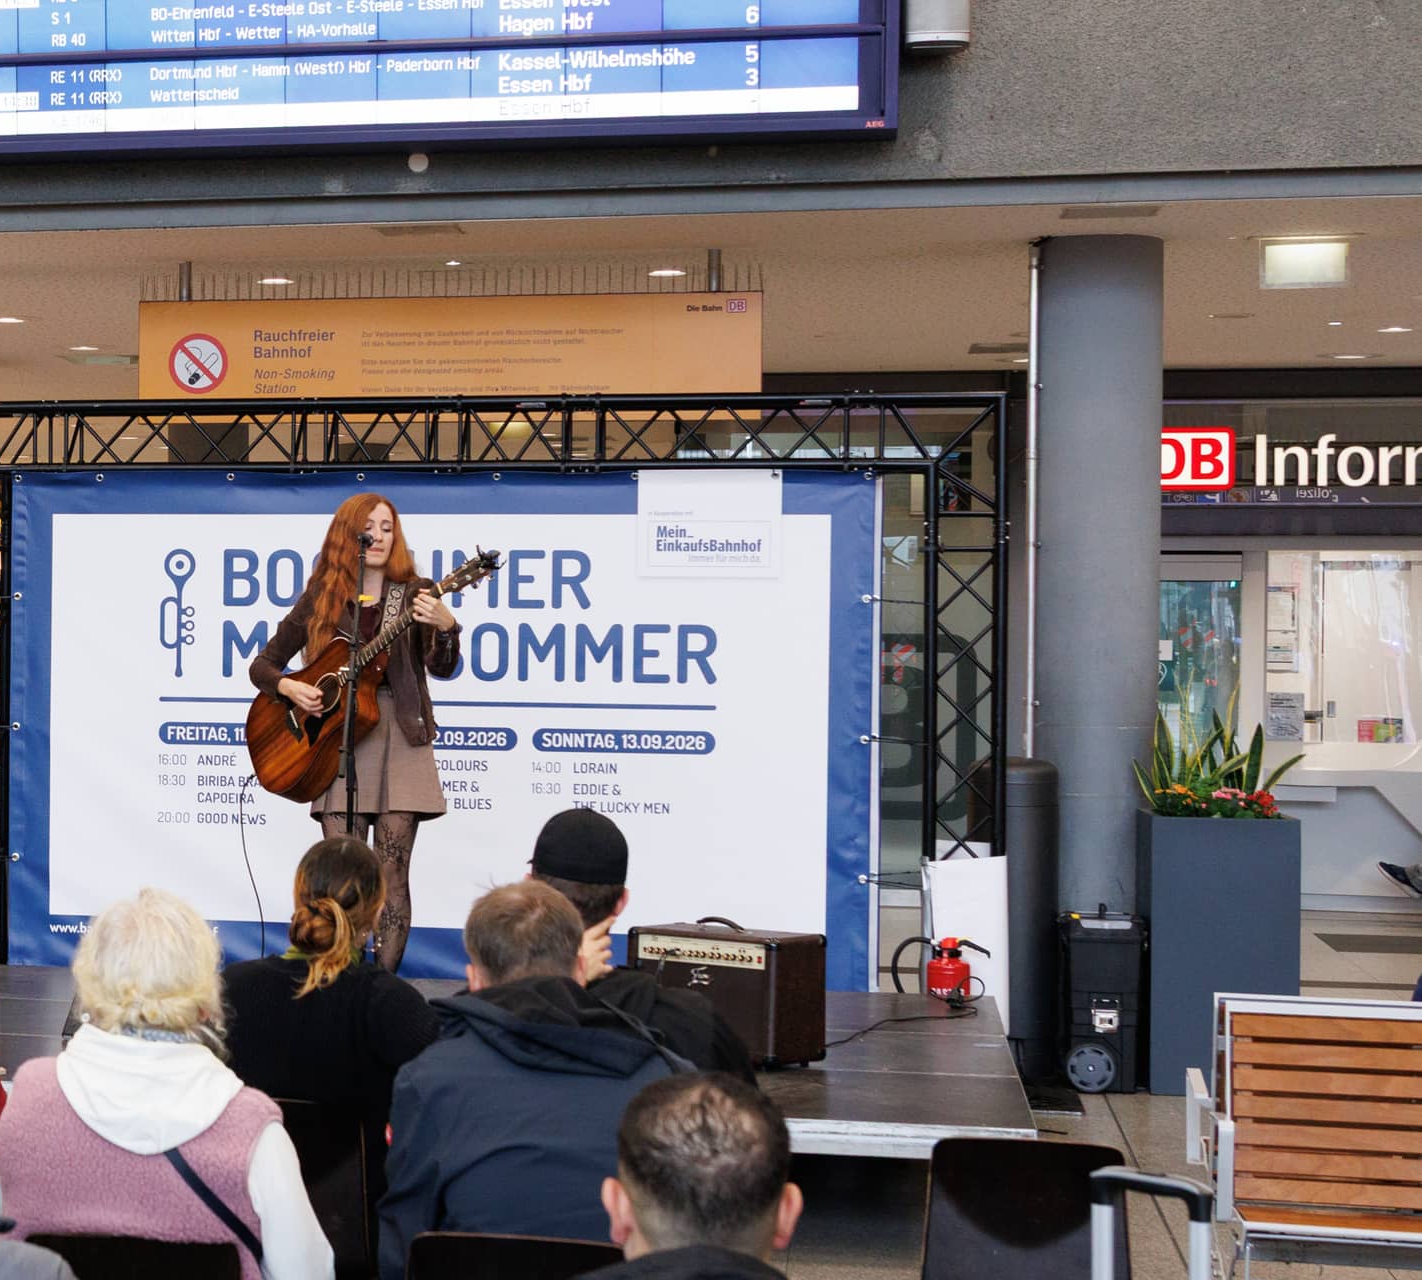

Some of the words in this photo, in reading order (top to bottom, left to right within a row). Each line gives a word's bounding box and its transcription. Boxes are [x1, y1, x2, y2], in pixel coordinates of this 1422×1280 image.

[51, 12, 59, 25] S
[64, 12, 70, 24] 1
[151, 5, 234, 21] BO-Ehrenfeld
[248, 2, 304, 17] E-Steele
[309, 1, 332, 15] Ost
[346, 0, 403, 13] E-Steele
[418, 0, 457, 10] Essen
[51, 34, 66, 47] RB
[71, 33, 85, 46] 40
[151, 29, 194, 43] Witten
[199, 28, 221, 42] Hbf
[235, 26, 282, 40] Wetter
[297, 23, 376, 38] HA-Vorhalle
[499, 15, 554, 36] Hagen
[562, 12, 594, 31] Hbf
[746, 6, 760, 24] 6
[50, 71, 65, 84] RE
[71, 71, 85, 83] 11
[89, 69, 122, 83] (RRX)
[150, 66, 211, 81] Dortmund
[216, 64, 238, 79] Hbf
[252, 63, 290, 77] Hamm
[294, 61, 345, 76] (Westf)
[349, 60, 371, 74] Hbf
[387, 57, 453, 73] Paderborn
[457, 56, 481, 71] Hbf
[498, 48, 696, 71] Kassel-Wilhelmshöhe
[746, 45, 759, 63] 5
[50, 93, 65, 106] RE
[71, 92, 85, 105] 11
[89, 91, 122, 105] (RRX)
[150, 87, 239, 103] Wattenscheid
[498, 76, 552, 94] Essen
[560, 74, 592, 92] Hbf
[746, 68, 759, 86] 3
[686, 304, 700, 312] Die
[702, 304, 722, 312] Bahn
[730, 302, 744, 311] DB
[254, 329, 335, 343] Rauchfreier
[254, 346, 312, 359] Bahnhof
[254, 368, 335, 380] Non-Smoking
[254, 383, 296, 394] Station
[1161, 438, 1224, 480] DB
[656, 539, 762, 552] EinkaufsBahnhof
[223, 549, 591, 609] BOMER
[223, 620, 718, 685] MOMMER
[167, 726, 231, 744] FREITAG,
[432, 731, 507, 746] 2.09.2026
[542, 732, 618, 750] SONNTAG,
[621, 734, 706, 750] 13.09.2026
[158, 753, 187, 766] 16:00
[197, 752, 237, 766] ANDRÉ
[532, 761, 562, 774] 14:00
[573, 762, 618, 775] LORAIN
[158, 774, 186, 786] 18:30
[197, 775, 235, 787] BIRIBA
[238, 776, 262, 787] BRA
[442, 780, 467, 792] MER
[470, 781, 480, 792] &
[531, 782, 561, 794] 16:30
[573, 783, 609, 795] EDDIE
[612, 784, 621, 796] &
[197, 792, 255, 804] CAPOEIRA
[454, 798, 492, 810] BLUES
[600, 801, 640, 814] LUCKY
[644, 803, 670, 814] MEN
[157, 811, 190, 824] 20:00
[197, 812, 229, 824] GOOD
[231, 813, 267, 825] NEWS
[49, 921, 91, 934] www.b
